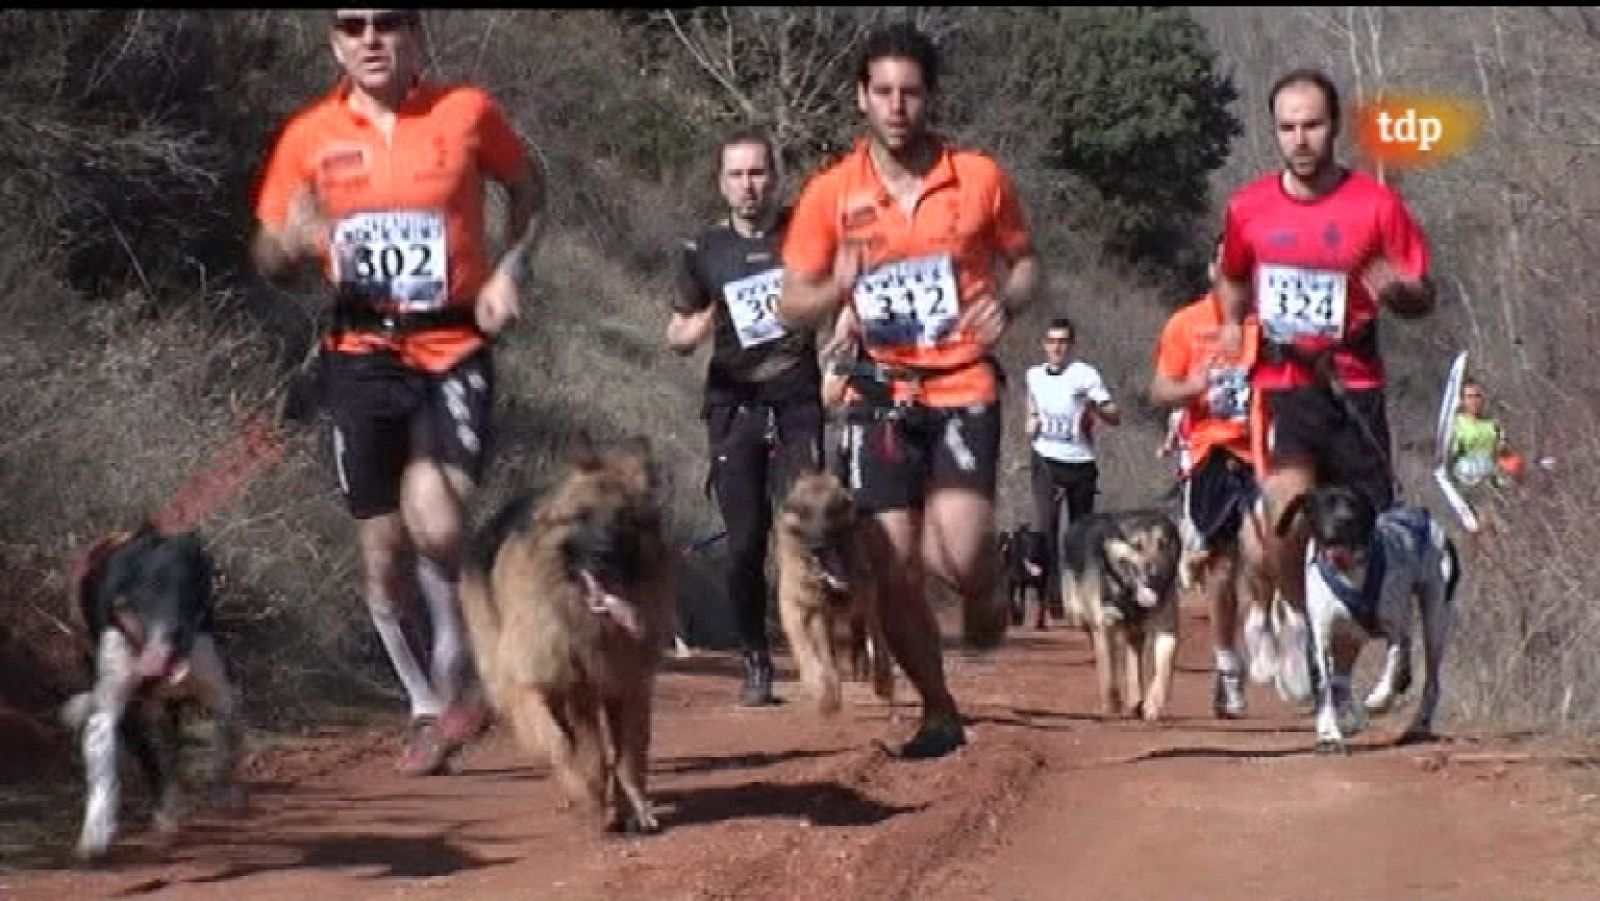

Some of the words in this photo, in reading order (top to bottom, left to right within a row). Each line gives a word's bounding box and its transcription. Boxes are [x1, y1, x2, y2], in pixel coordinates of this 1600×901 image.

[354, 244, 433, 277] 302
[875, 287, 948, 321] 312
[1275, 293, 1334, 320] 324
